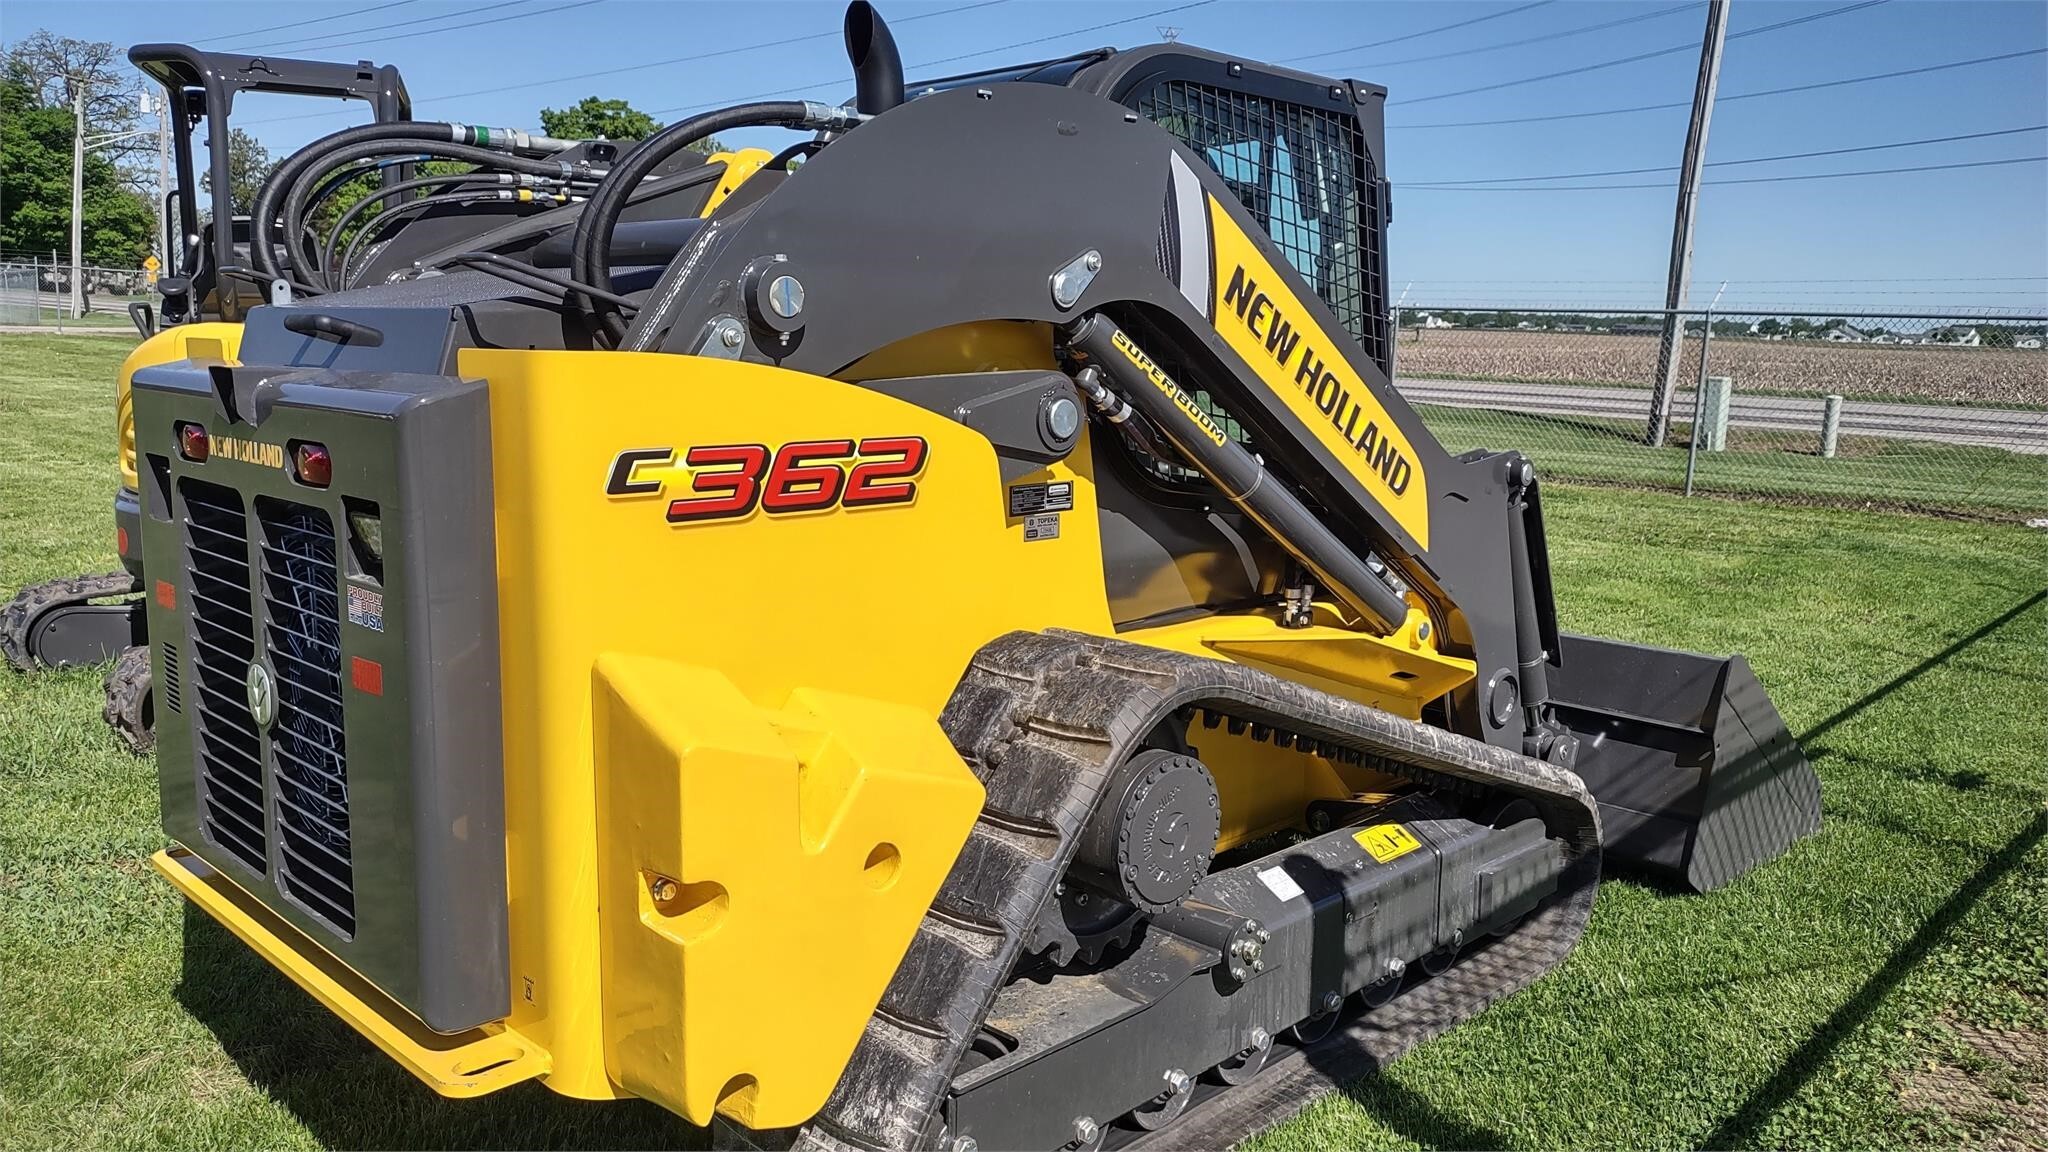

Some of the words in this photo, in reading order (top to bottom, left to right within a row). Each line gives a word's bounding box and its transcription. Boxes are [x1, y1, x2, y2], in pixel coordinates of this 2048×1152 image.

[1223, 263, 1301, 367] NEW
[1294, 346, 1412, 496] HOLLAND
[208, 434, 233, 459] NEW
[233, 438, 284, 469] HOLLAND
[1037, 516, 1058, 525] TOPEKA
[347, 585, 383, 605] PROUDLY
[361, 601, 383, 617] BUILT
[362, 613, 384, 632] USA
